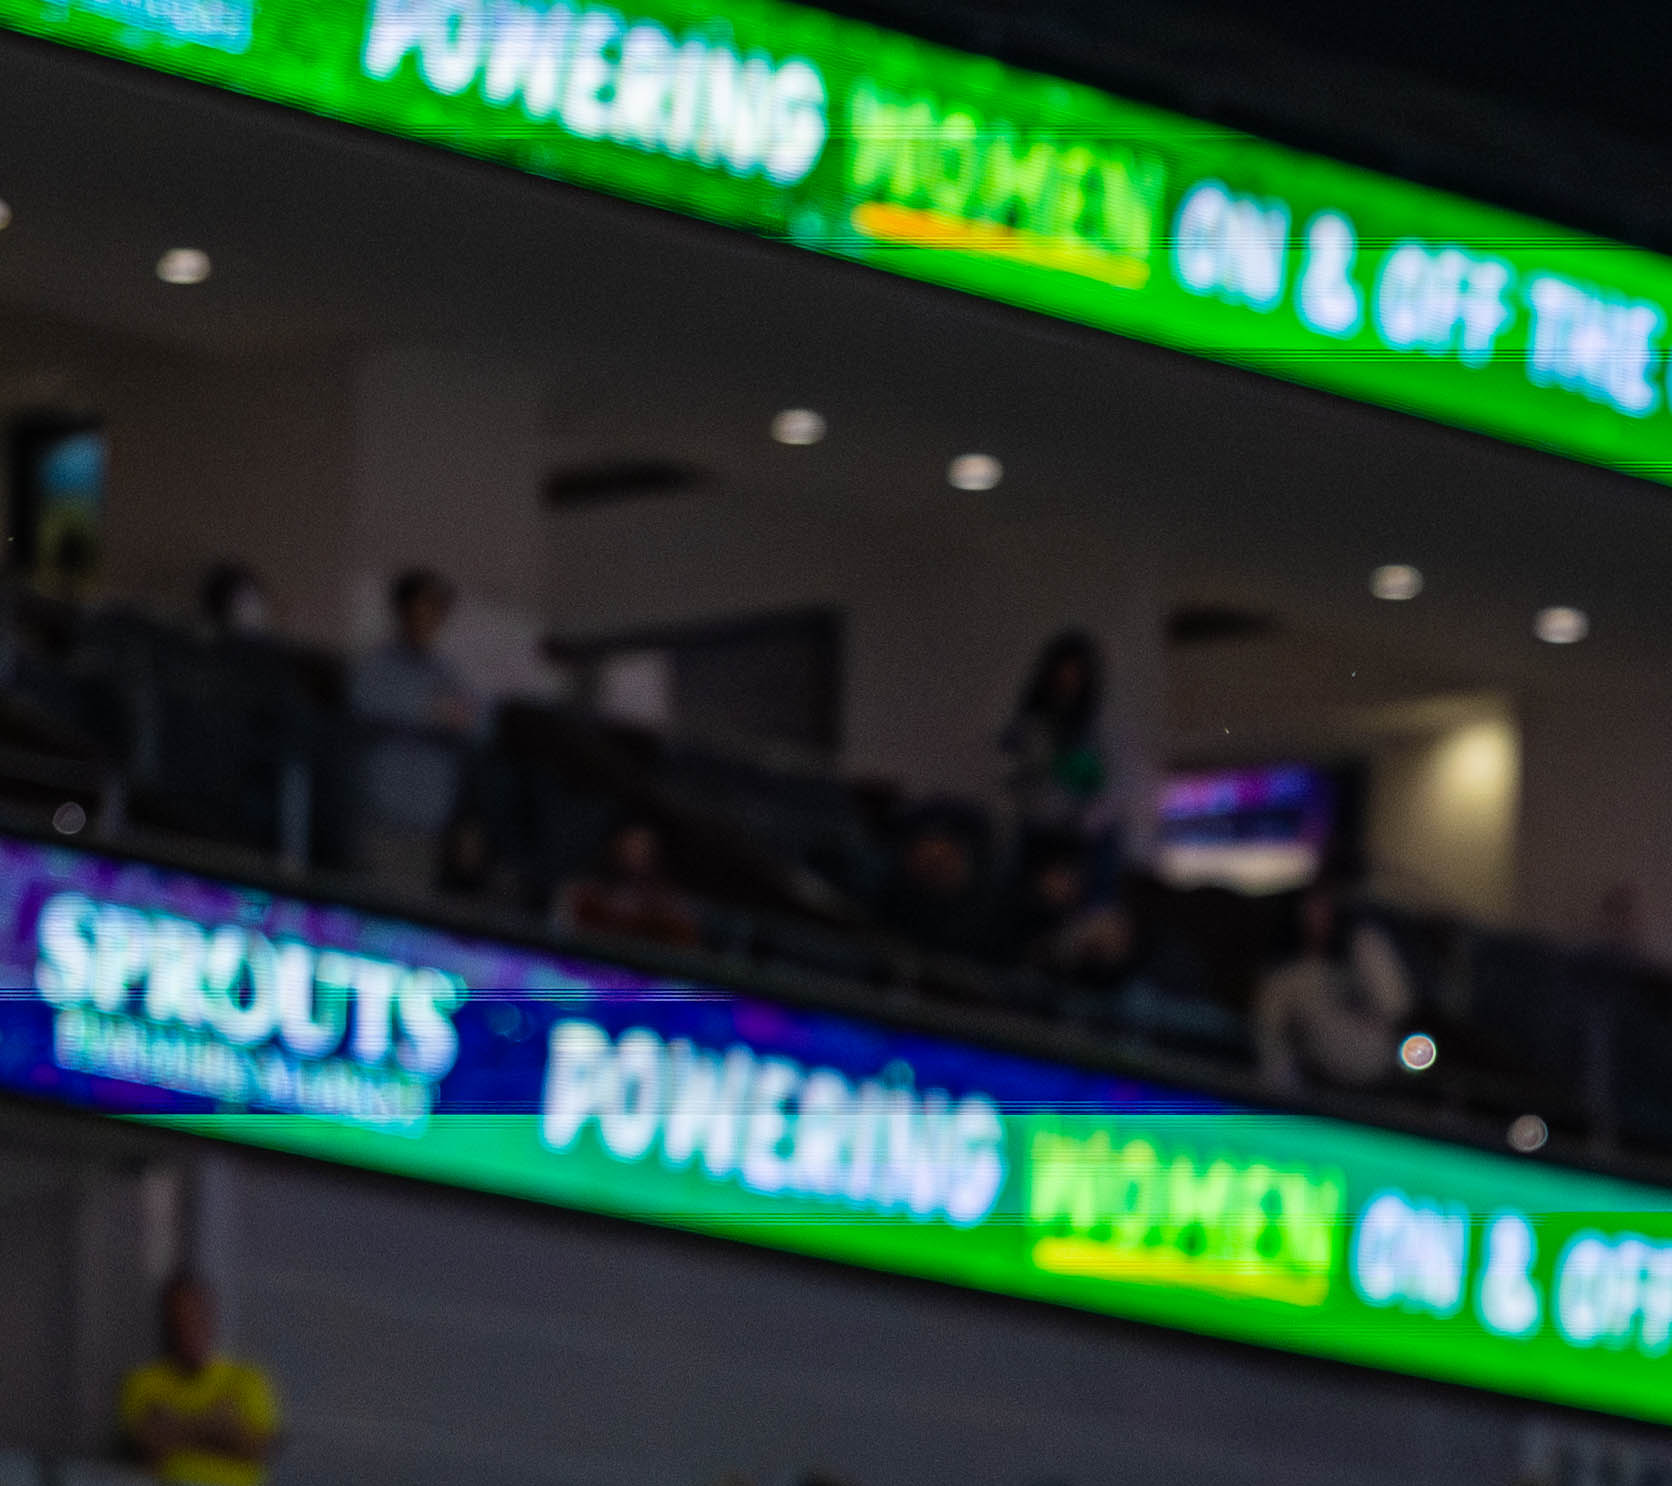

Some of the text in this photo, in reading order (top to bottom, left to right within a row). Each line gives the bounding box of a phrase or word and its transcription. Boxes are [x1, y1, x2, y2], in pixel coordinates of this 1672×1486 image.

[363, 0, 828, 185] POWERING
[1176, 183, 1292, 310] ON
[1299, 212, 1361, 336] &
[1378, 244, 1510, 366] OFF
[1525, 273, 1662, 415] THE
[36, 893, 467, 1082] SPROUTS
[538, 1018, 1008, 1229] POWERING
[1028, 1113, 1345, 1285] WOMEN
[1350, 1191, 1468, 1315] ON
[1479, 1206, 1541, 1339] &
